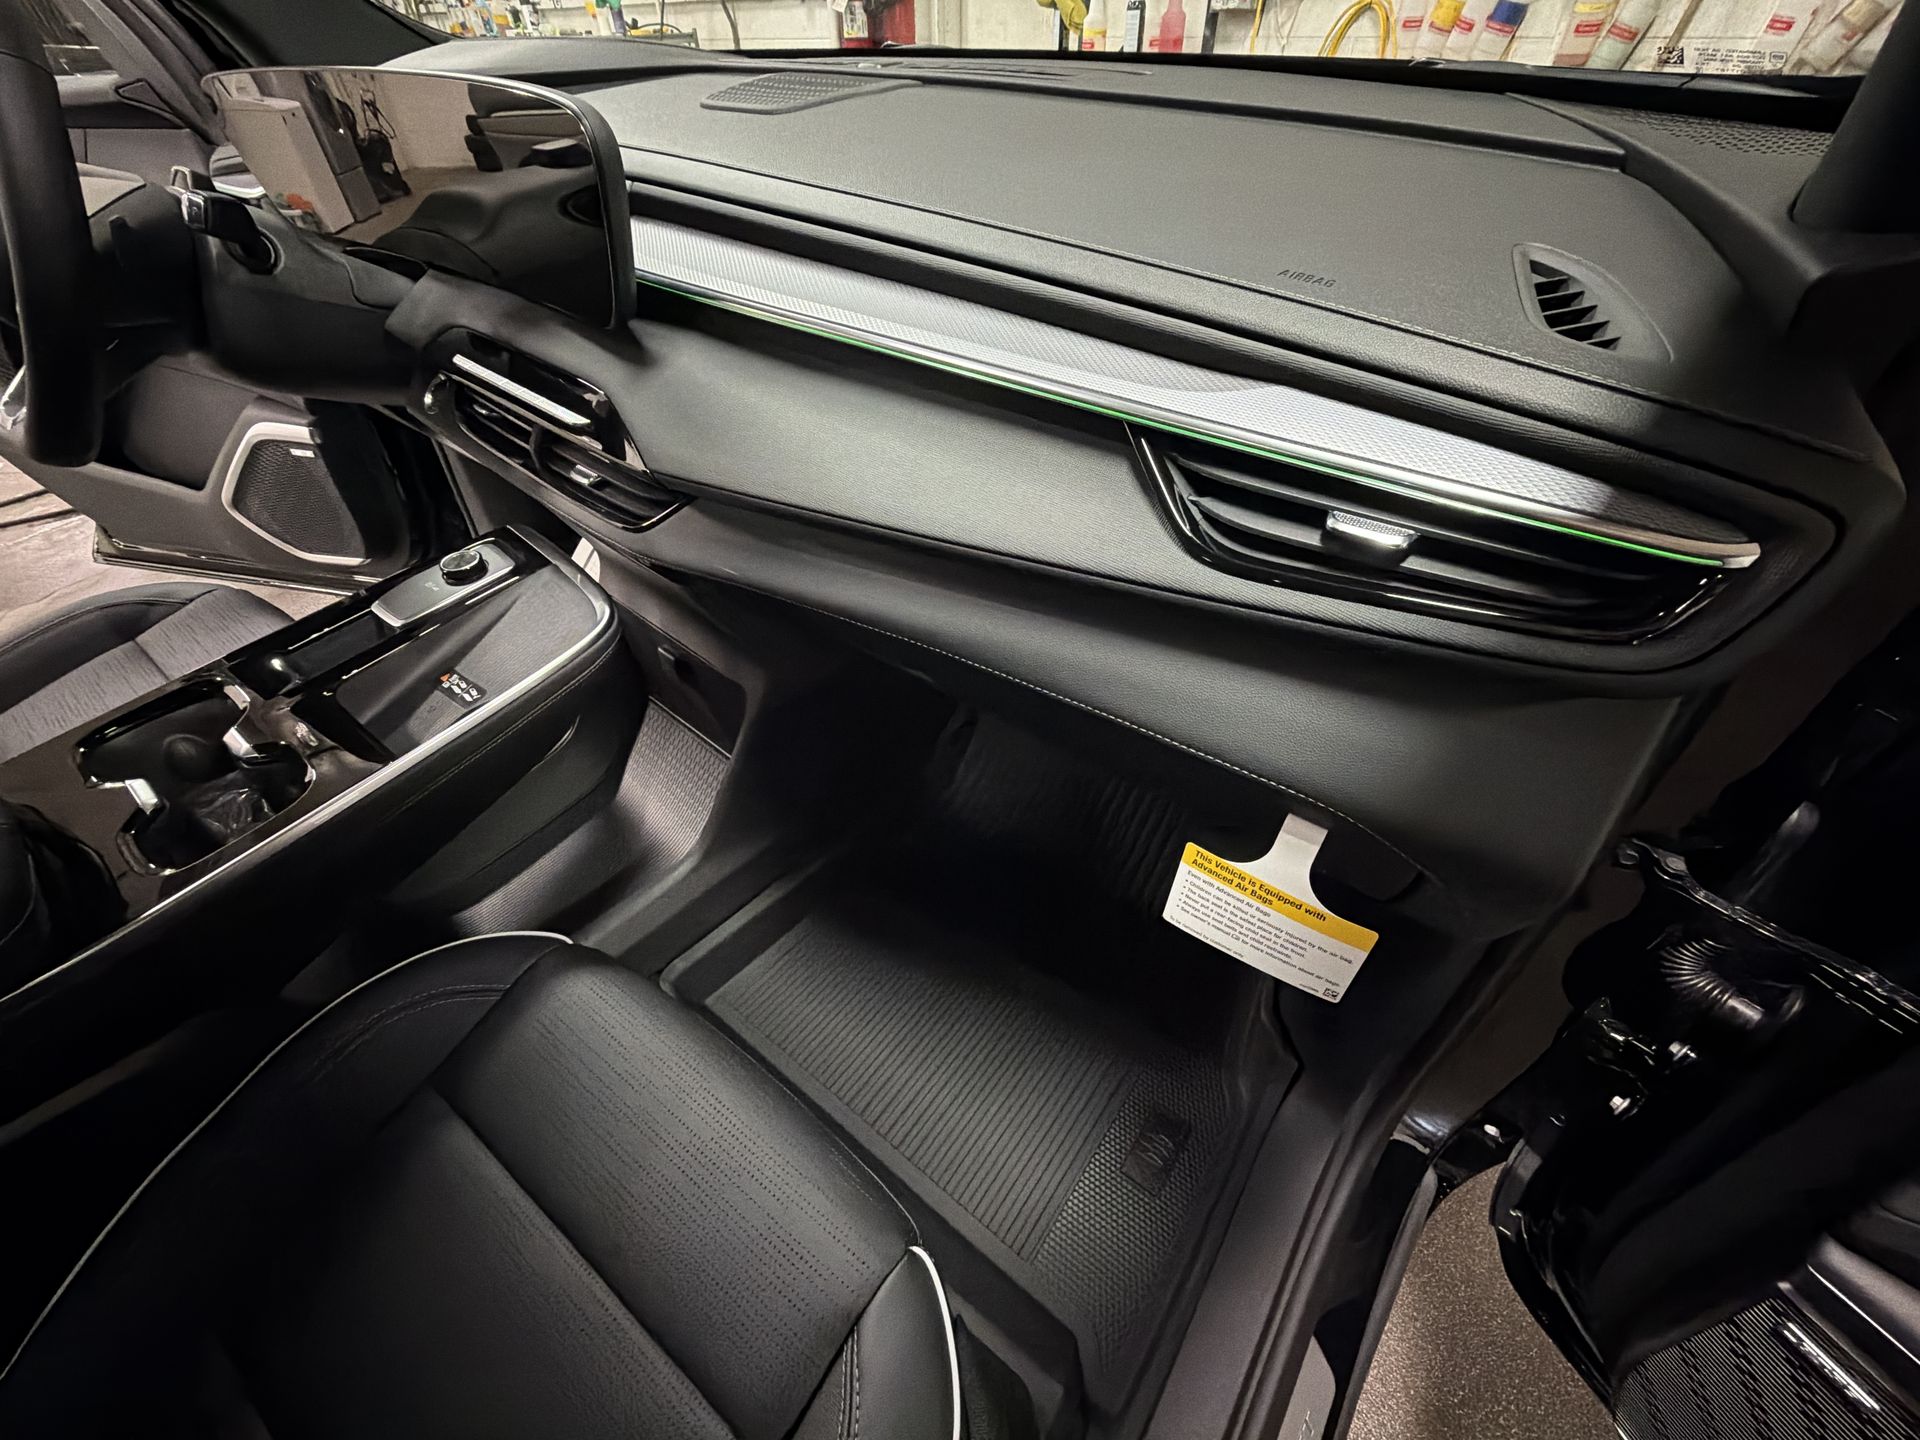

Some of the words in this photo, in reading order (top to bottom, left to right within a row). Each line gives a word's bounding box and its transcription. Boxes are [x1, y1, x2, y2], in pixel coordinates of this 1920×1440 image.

[1277, 269, 1337, 287] AIRBAG
[1192, 859, 1234, 885] Advanced
[1235, 882, 1248, 893] Air
[1250, 890, 1273, 906] Bags
[1196, 851, 1213, 864] This
[1214, 861, 1246, 882] Vehicle
[1248, 879, 1257, 887] is
[1258, 884, 1302, 911] Equipped
[1304, 907, 1326, 921] with
